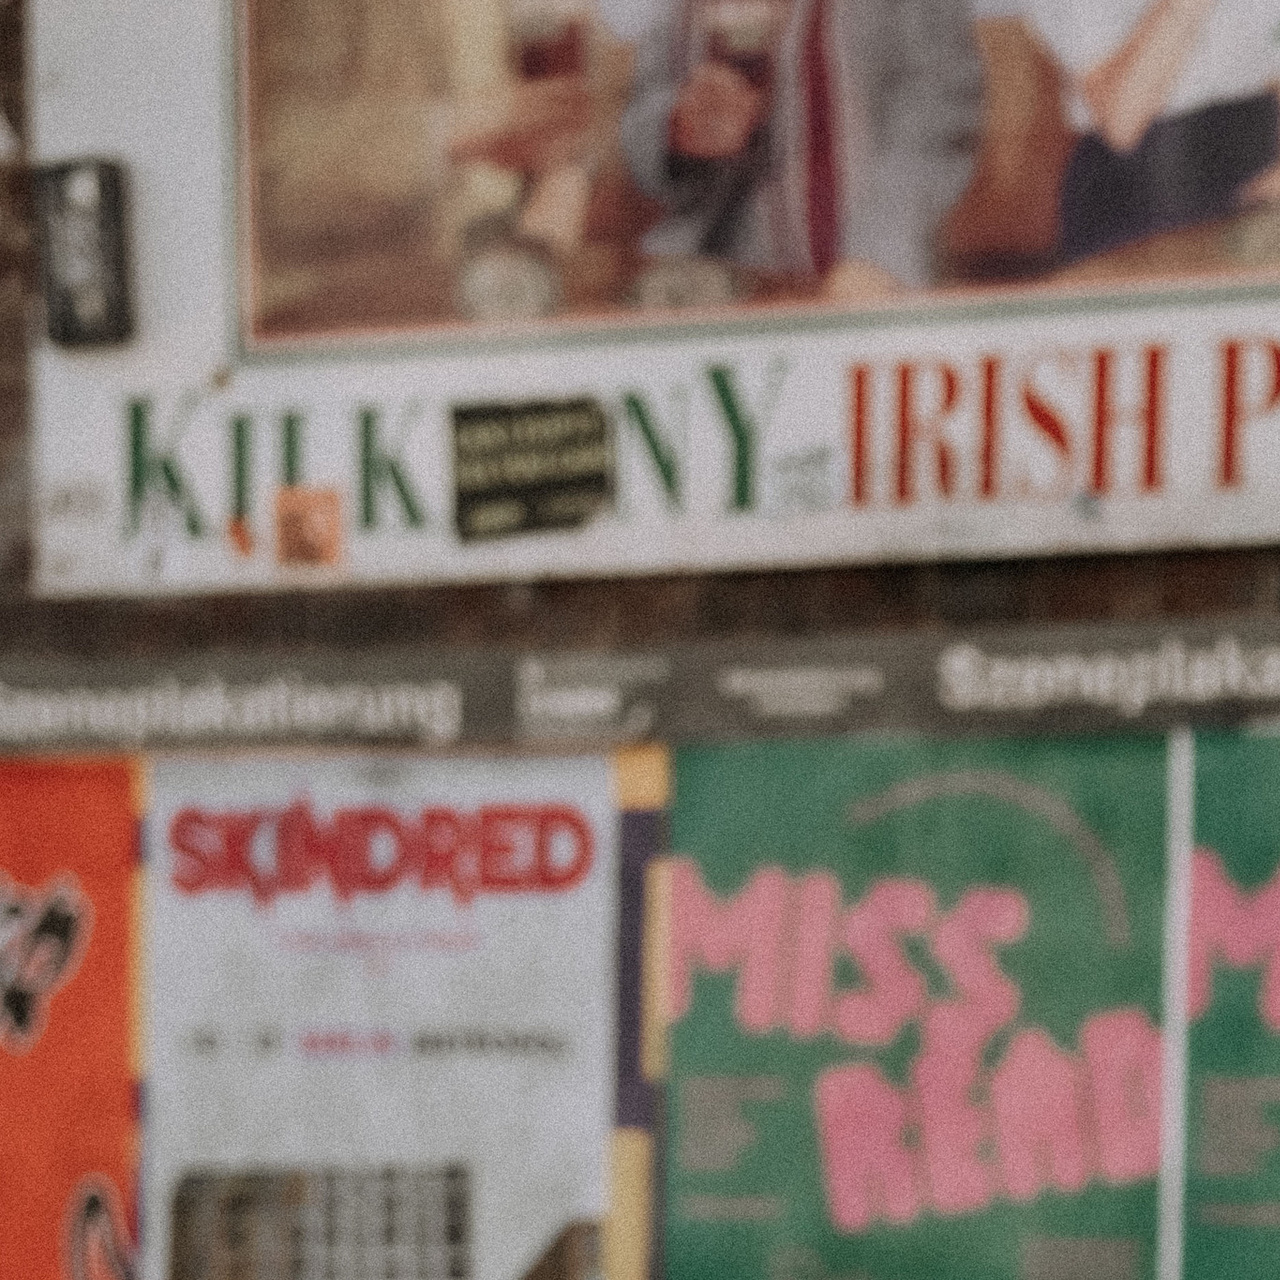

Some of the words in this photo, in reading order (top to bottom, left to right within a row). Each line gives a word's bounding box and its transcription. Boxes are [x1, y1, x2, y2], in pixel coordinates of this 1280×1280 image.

[118, 358, 792, 540] KIKNY
[845, 340, 1170, 508] IRISH
[0, 672, 462, 748] zeneplakatierung
[168, 790, 596, 908] SKINDRED
[666, 853, 1030, 1046] MISS
[813, 1003, 1164, 1235] READ
